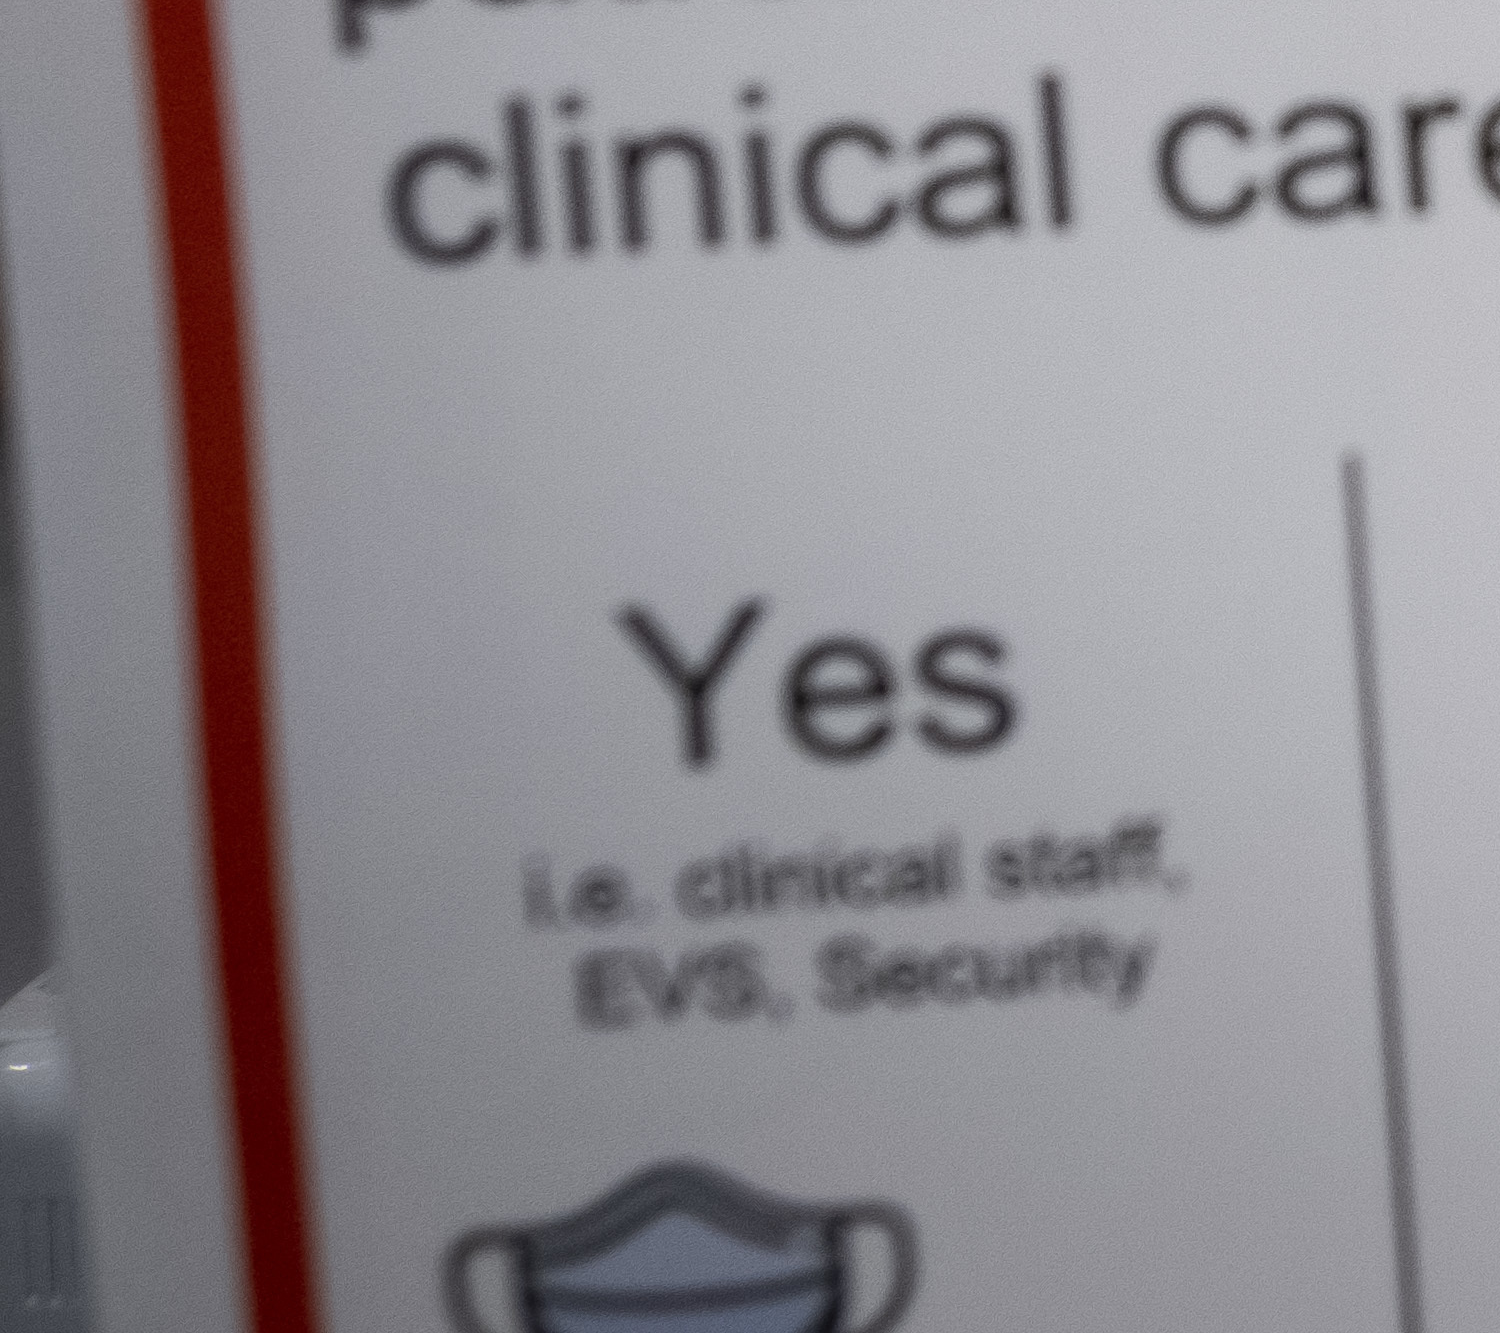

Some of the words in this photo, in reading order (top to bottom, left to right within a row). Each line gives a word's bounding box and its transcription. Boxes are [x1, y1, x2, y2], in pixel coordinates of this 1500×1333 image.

[386, 72, 1075, 269] clinical
[616, 597, 1020, 769] Yes
[522, 855, 650, 930] i.e.
[678, 831, 955, 921] clinical
[981, 811, 1186, 905] staff,
[570, 947, 791, 1025] EVS,
[814, 923, 1155, 1011] Security
